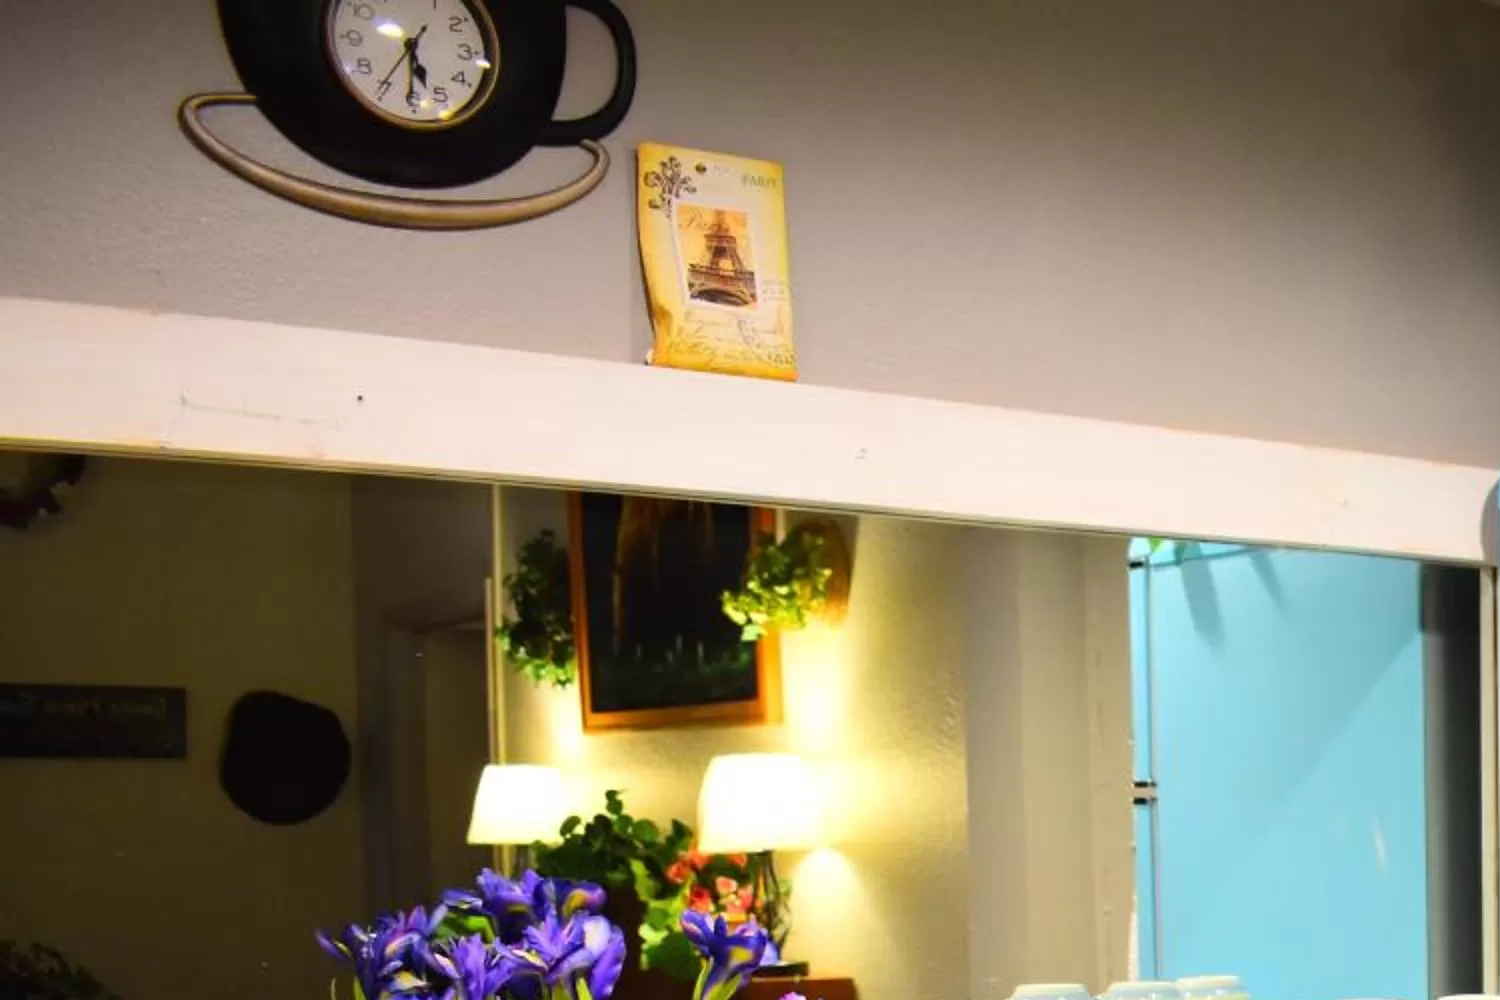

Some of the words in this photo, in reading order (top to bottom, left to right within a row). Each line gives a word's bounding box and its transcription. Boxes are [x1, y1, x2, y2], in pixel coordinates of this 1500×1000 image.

[448, 15, 463, 33] 2
[346, 29, 363, 47] 9
[456, 43, 473, 61] 3
[356, 57, 372, 75] 8
[450, 71, 466, 87] 4
[433, 87, 449, 103] 5
